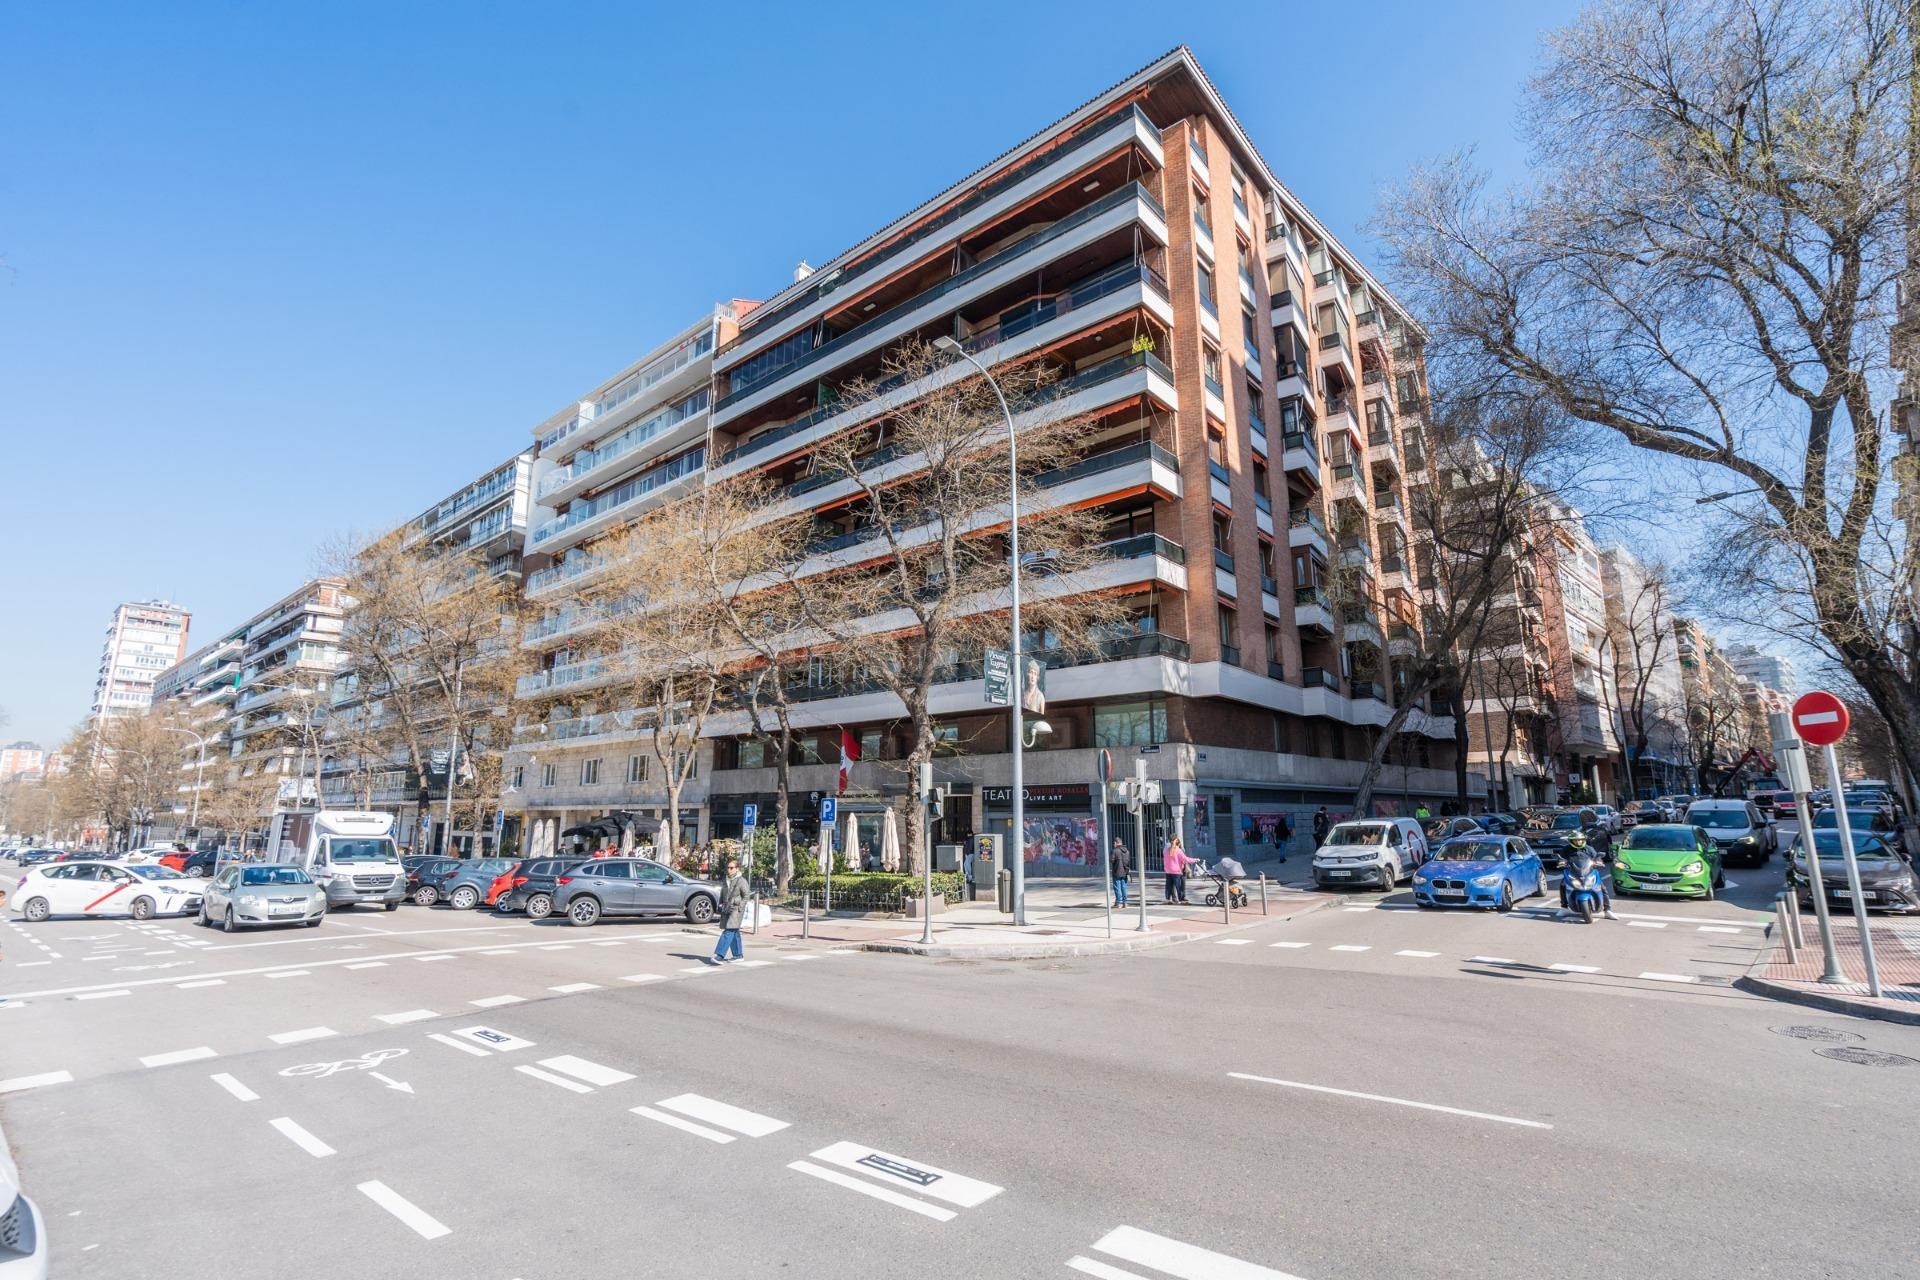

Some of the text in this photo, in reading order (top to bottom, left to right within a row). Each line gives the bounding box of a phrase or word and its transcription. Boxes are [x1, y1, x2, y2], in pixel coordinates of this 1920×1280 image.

[983, 789, 1030, 801] TEATO
[745, 806, 753, 823] P
[823, 801, 832, 818] P
